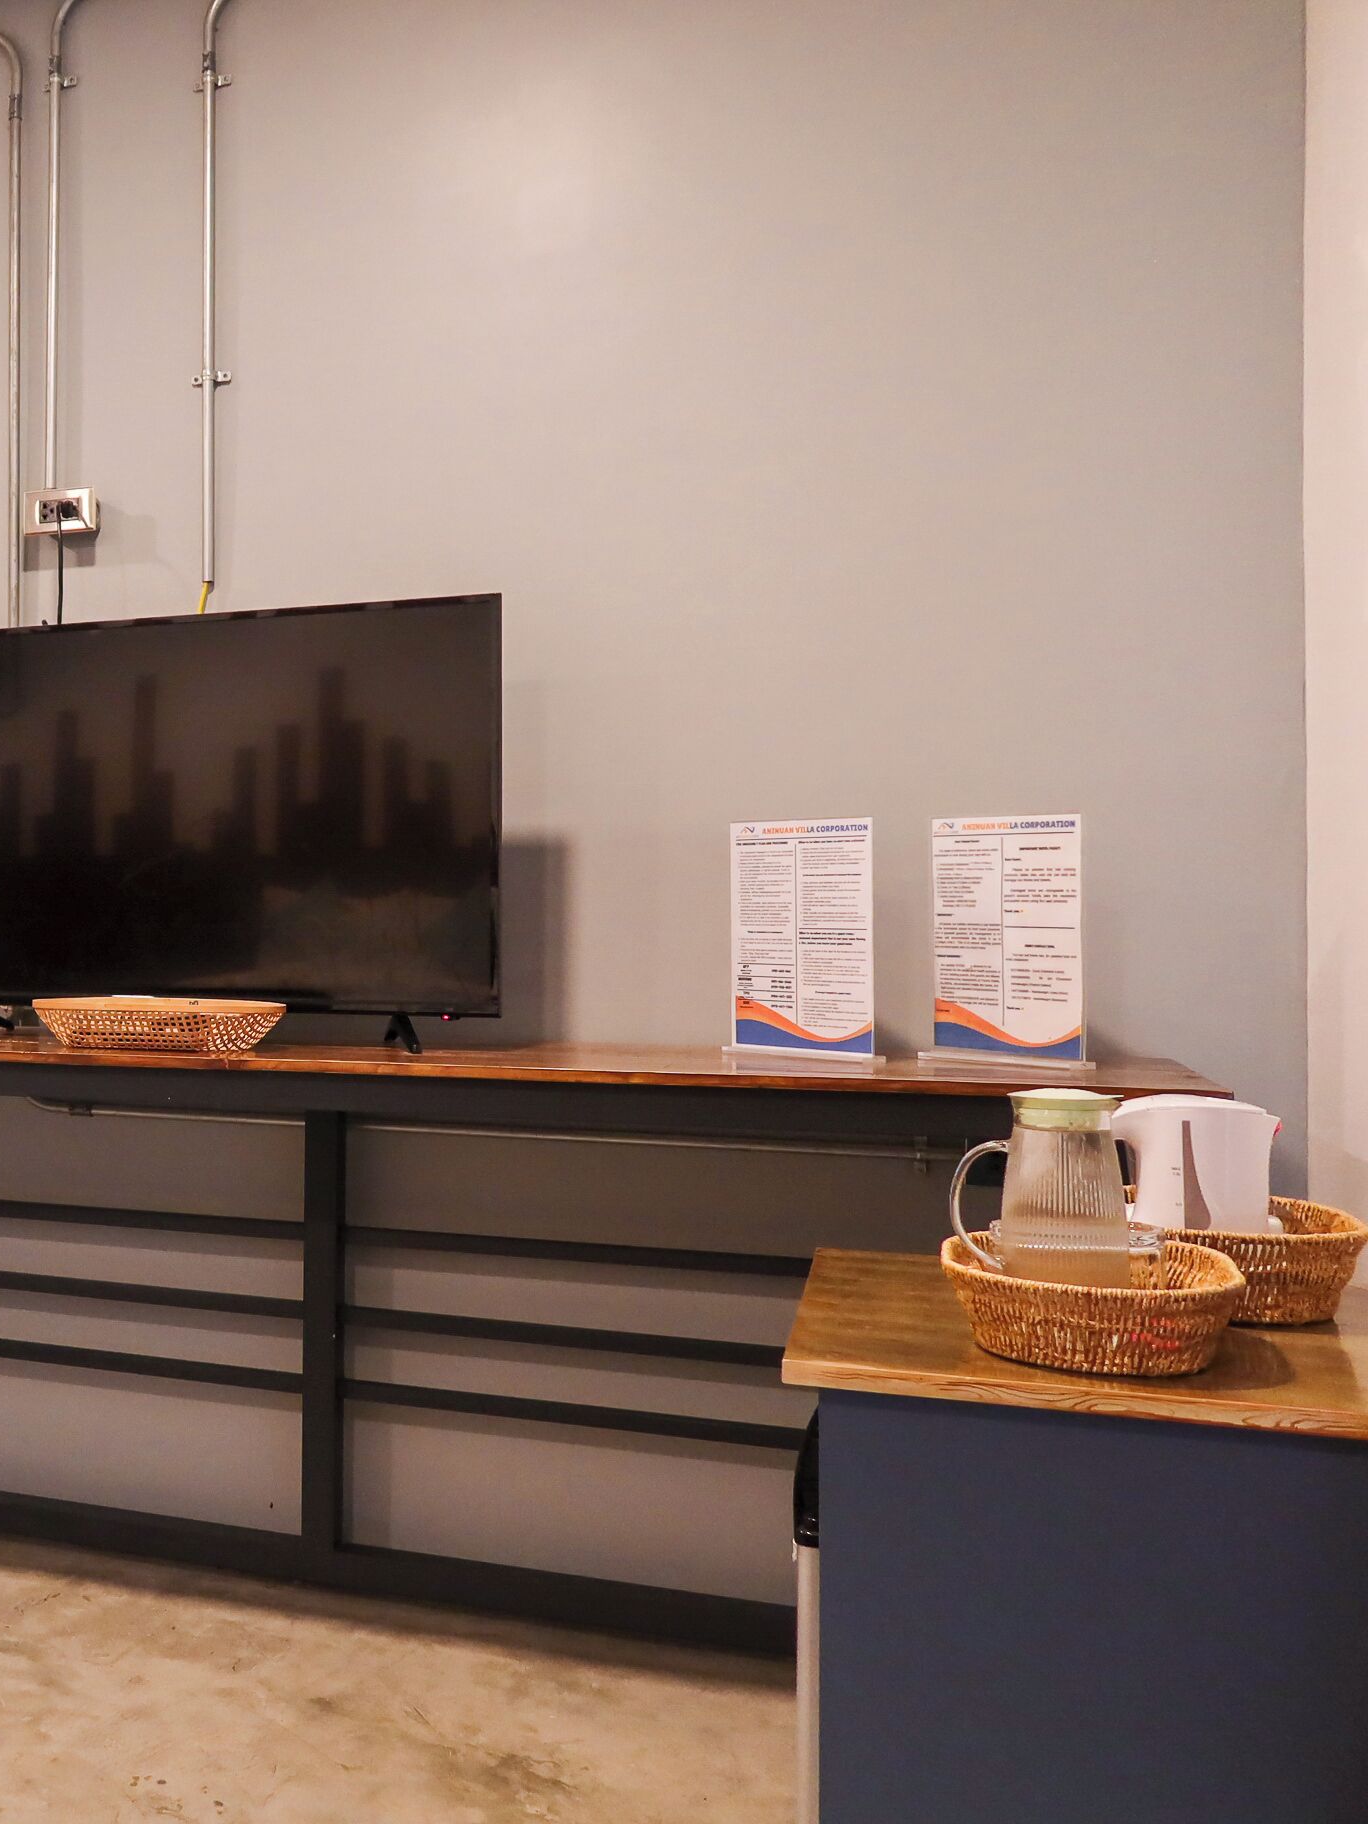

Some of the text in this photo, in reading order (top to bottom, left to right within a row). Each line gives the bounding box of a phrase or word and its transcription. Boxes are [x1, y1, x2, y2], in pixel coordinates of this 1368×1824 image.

[795, 826, 815, 834] VILLA
[816, 824, 869, 833] CORPORATION
[996, 821, 1018, 830] VILLA
[1020, 819, 1076, 829] CORPORATION
